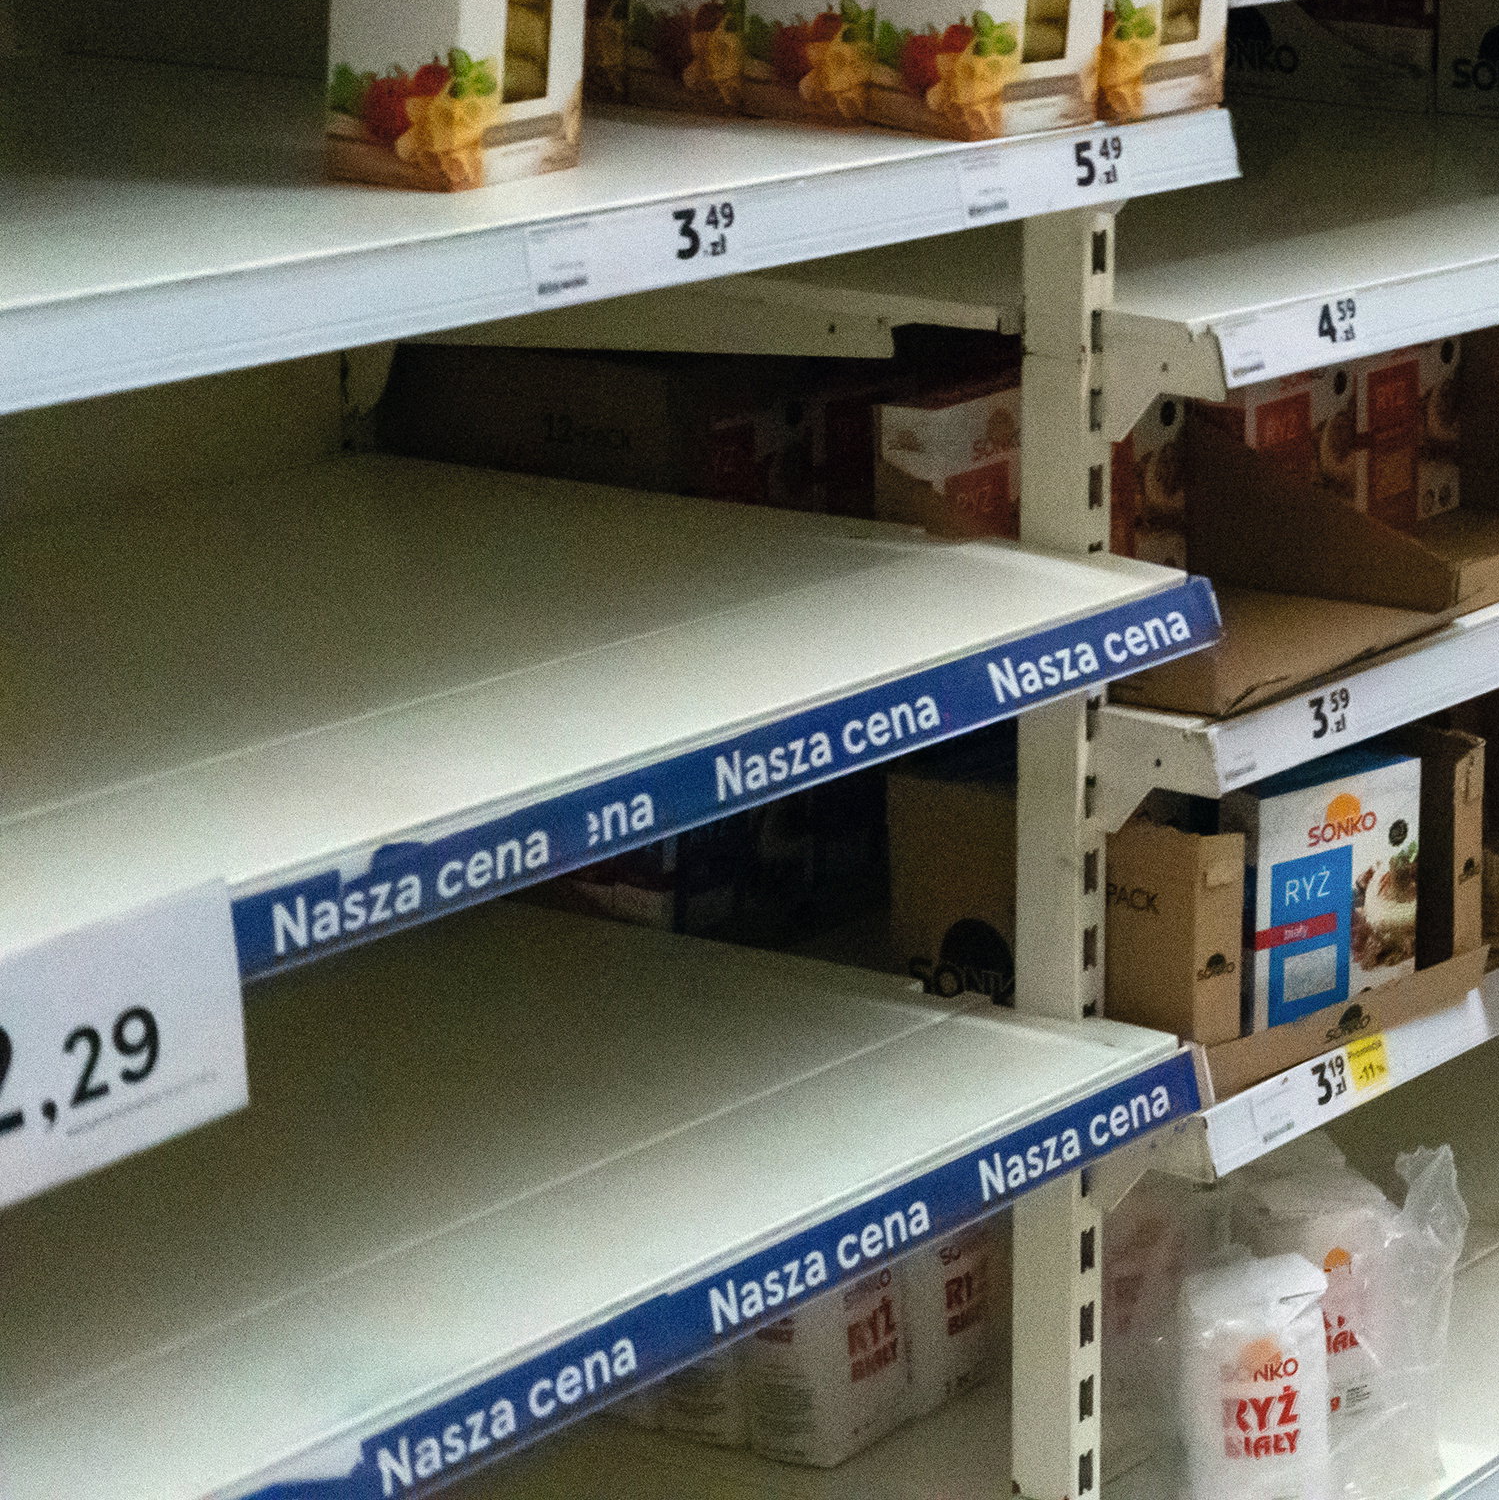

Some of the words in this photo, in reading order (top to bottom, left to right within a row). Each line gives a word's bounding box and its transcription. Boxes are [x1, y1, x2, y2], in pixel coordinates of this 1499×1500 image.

[270, 870, 421, 957] Nasza
[437, 829, 550, 899] cena
[714, 729, 833, 802] Nasza
[843, 691, 941, 756] cena
[987, 636, 1100, 704] Nasza
[1103, 606, 1193, 666] cena
[1307, 811, 1377, 848] SONKO
[1284, 866, 1331, 907] RYŻ
[376, 1396, 517, 1496] Nasza
[528, 1337, 638, 1419] cena
[709, 1251, 827, 1335] Nasza
[836, 1200, 930, 1270] cena
[979, 1128, 1083, 1200] Nasza
[1089, 1082, 1170, 1149] cena
[1222, 1384, 1299, 1432] RYŻ
[1223, 1429, 1300, 1461] BIAŁY
